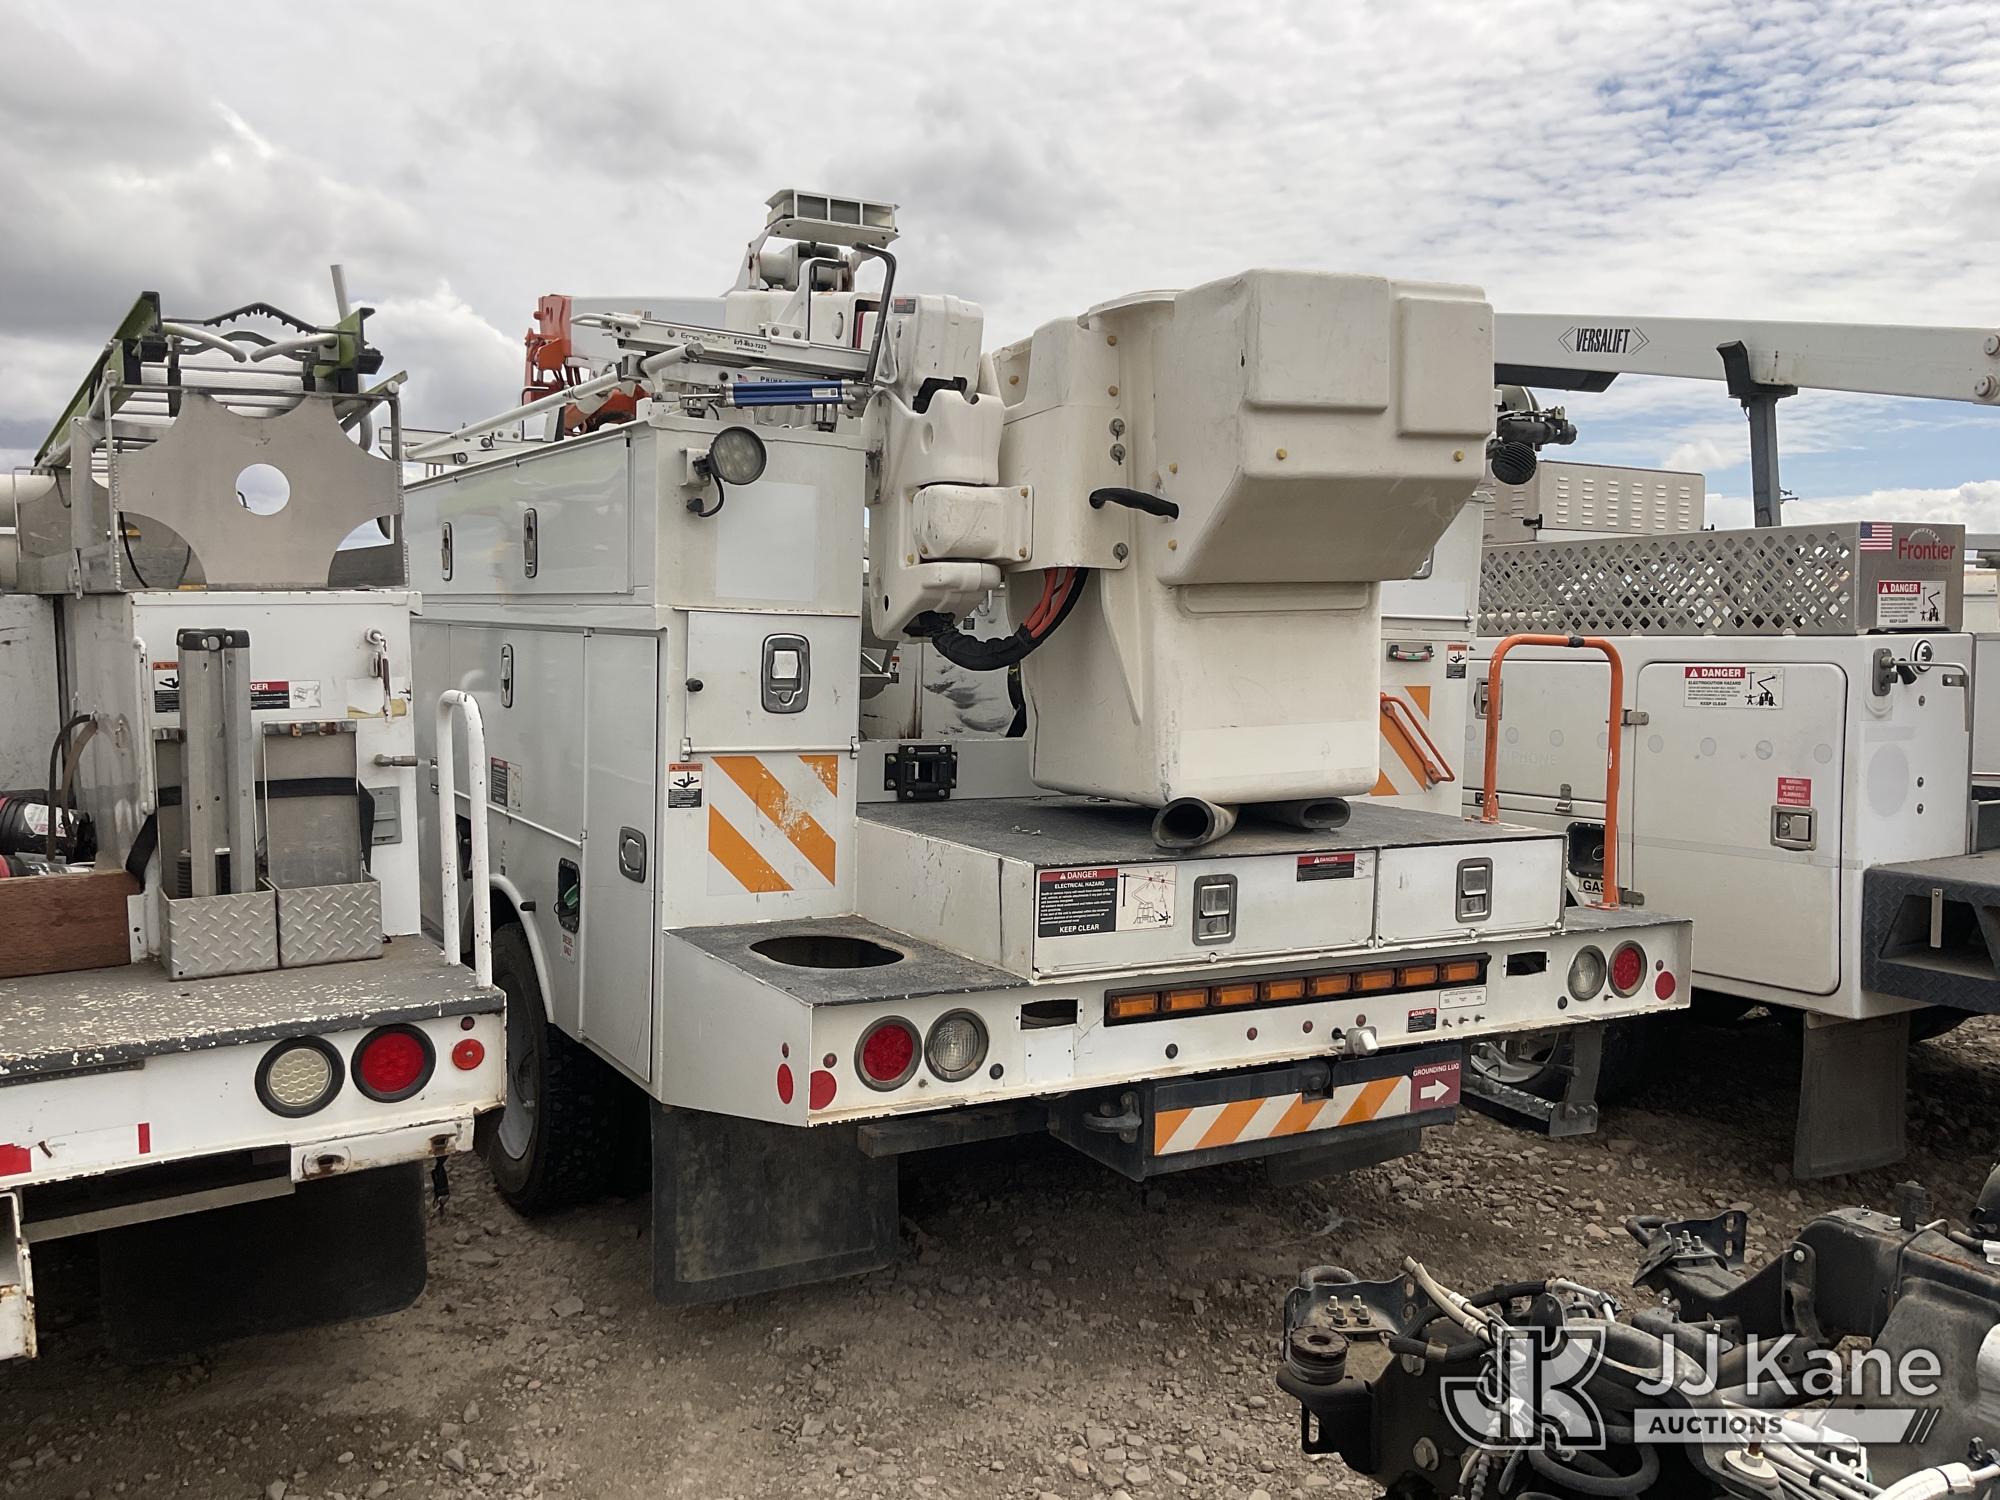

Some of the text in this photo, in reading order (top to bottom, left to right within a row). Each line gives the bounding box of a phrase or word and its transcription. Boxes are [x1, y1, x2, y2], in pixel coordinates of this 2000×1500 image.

[1576, 328, 1631, 354] VERSALIFT
[1898, 537, 1956, 560] Frontier
[1890, 583, 1918, 593] DANGER
[1701, 668, 1741, 678] DANGER
[1067, 870, 1098, 880] DANGER
[1085, 880, 1105, 888] HAZARD
[1060, 923, 1100, 933] KEEP CLEAR
[1413, 1063, 1460, 1077] GROUNDING LUG
